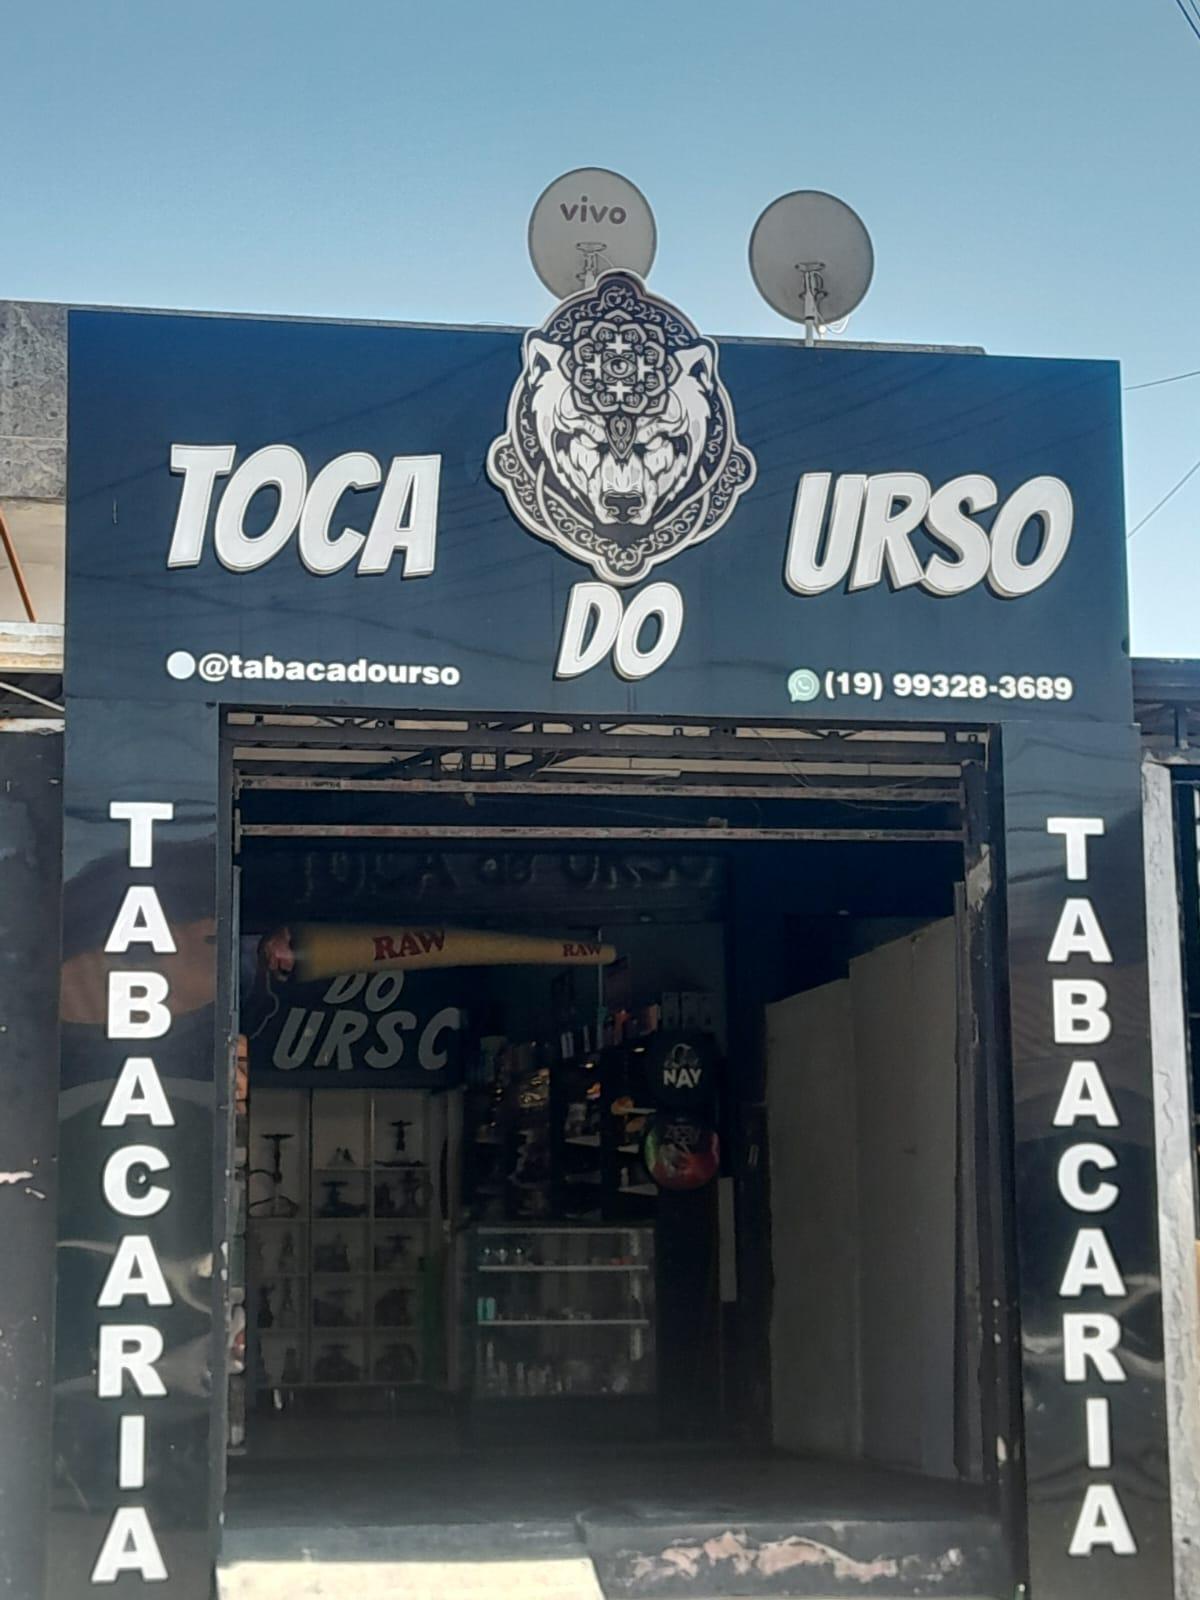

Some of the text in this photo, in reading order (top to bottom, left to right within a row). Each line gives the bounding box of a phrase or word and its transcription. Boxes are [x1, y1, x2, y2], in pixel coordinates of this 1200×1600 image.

[560, 196, 627, 225] vivo
[168, 444, 442, 578] TOCA
[785, 472, 1074, 598] URSO
[555, 582, 683, 681] DO
[199, 653, 461, 686] @tabacadourso
[825, 671, 1073, 701] (19) 99328-3689
[372, 929, 446, 961] RAW
[563, 943, 601, 957] RAW
[91, 801, 177, 1583] TABACARIA
[1046, 817, 1138, 1555] TABACARIA
